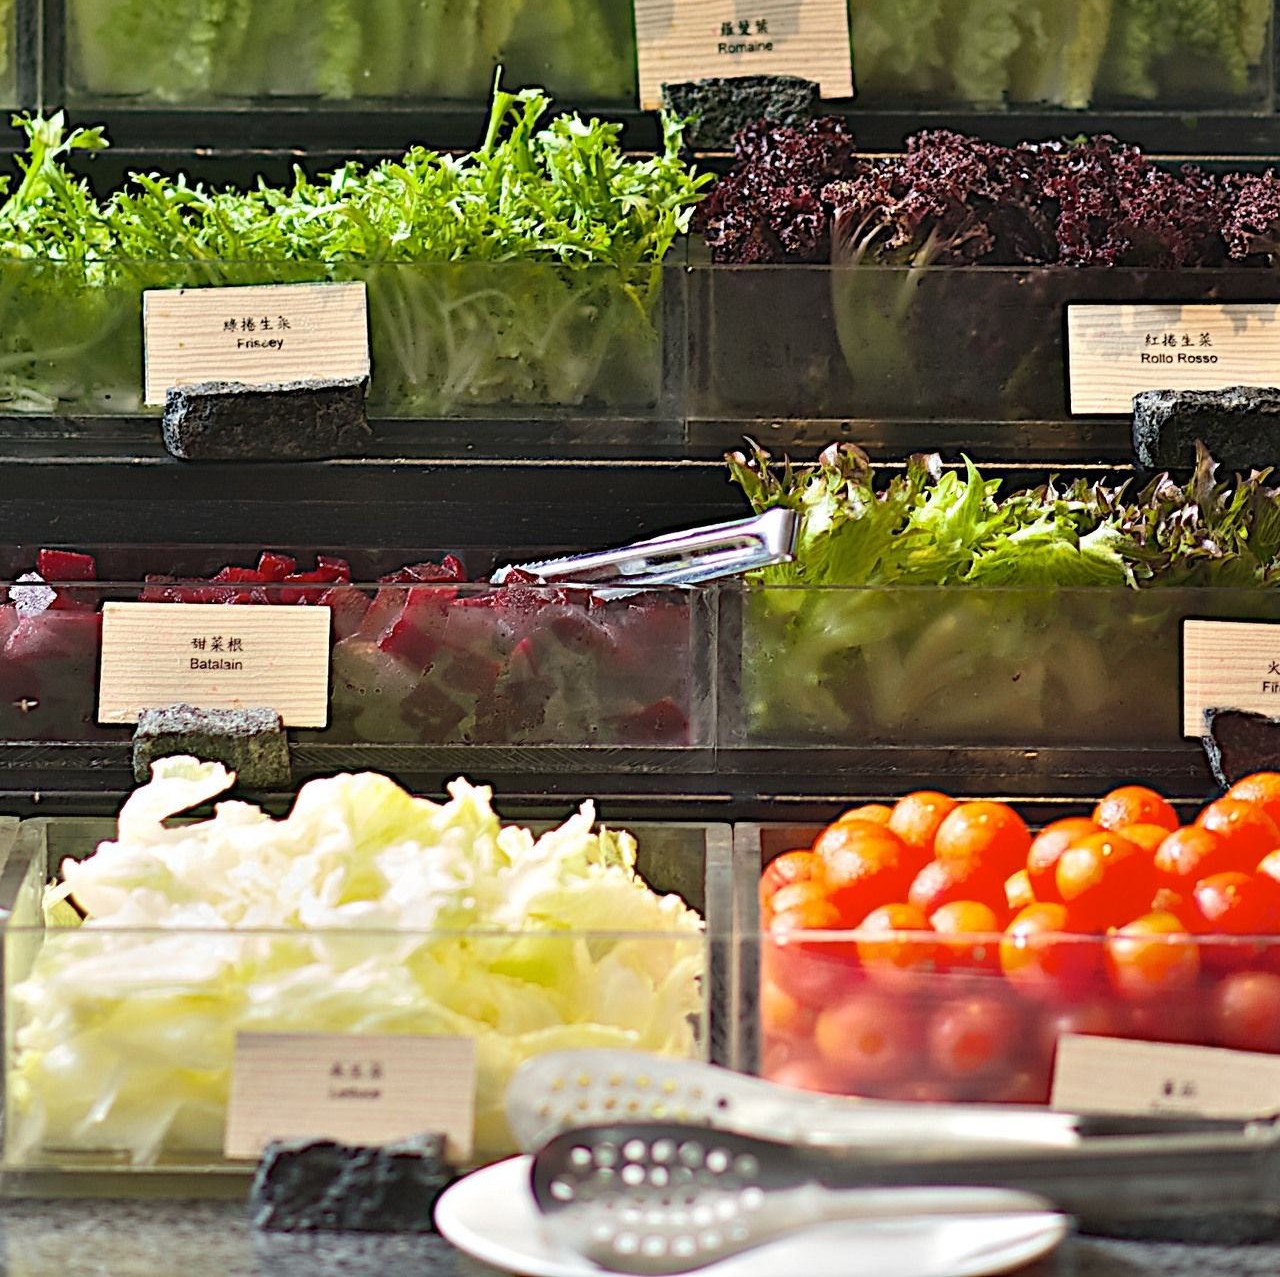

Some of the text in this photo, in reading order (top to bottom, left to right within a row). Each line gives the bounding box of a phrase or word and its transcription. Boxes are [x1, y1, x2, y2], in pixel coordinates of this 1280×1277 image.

[718, 41, 773, 53] Romaine
[1145, 332, 1213, 347] 紅捲生菜
[1177, 353, 1218, 363] Rosso
[190, 635, 244, 652] 甜菜根
